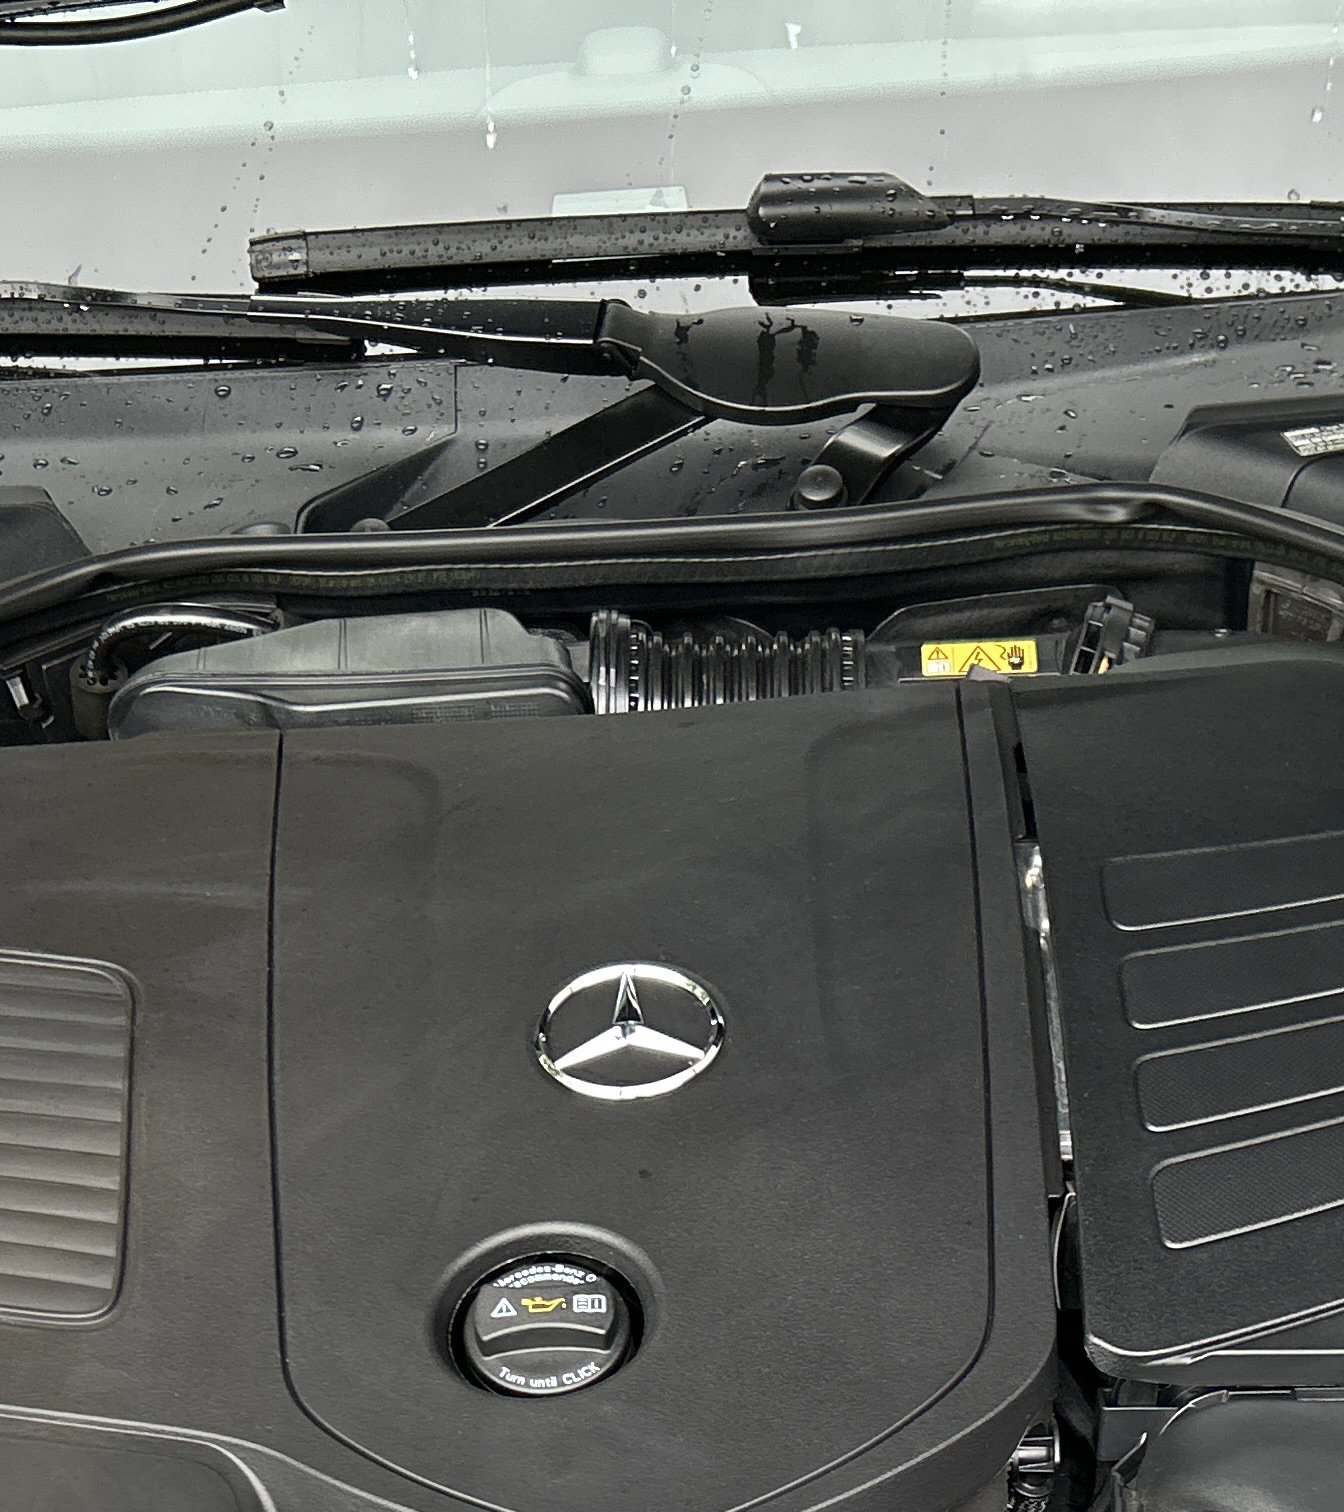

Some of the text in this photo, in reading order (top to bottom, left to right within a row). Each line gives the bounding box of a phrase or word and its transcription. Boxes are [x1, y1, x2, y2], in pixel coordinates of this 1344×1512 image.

[499, 1361, 601, 1388] Turn until CLICK
